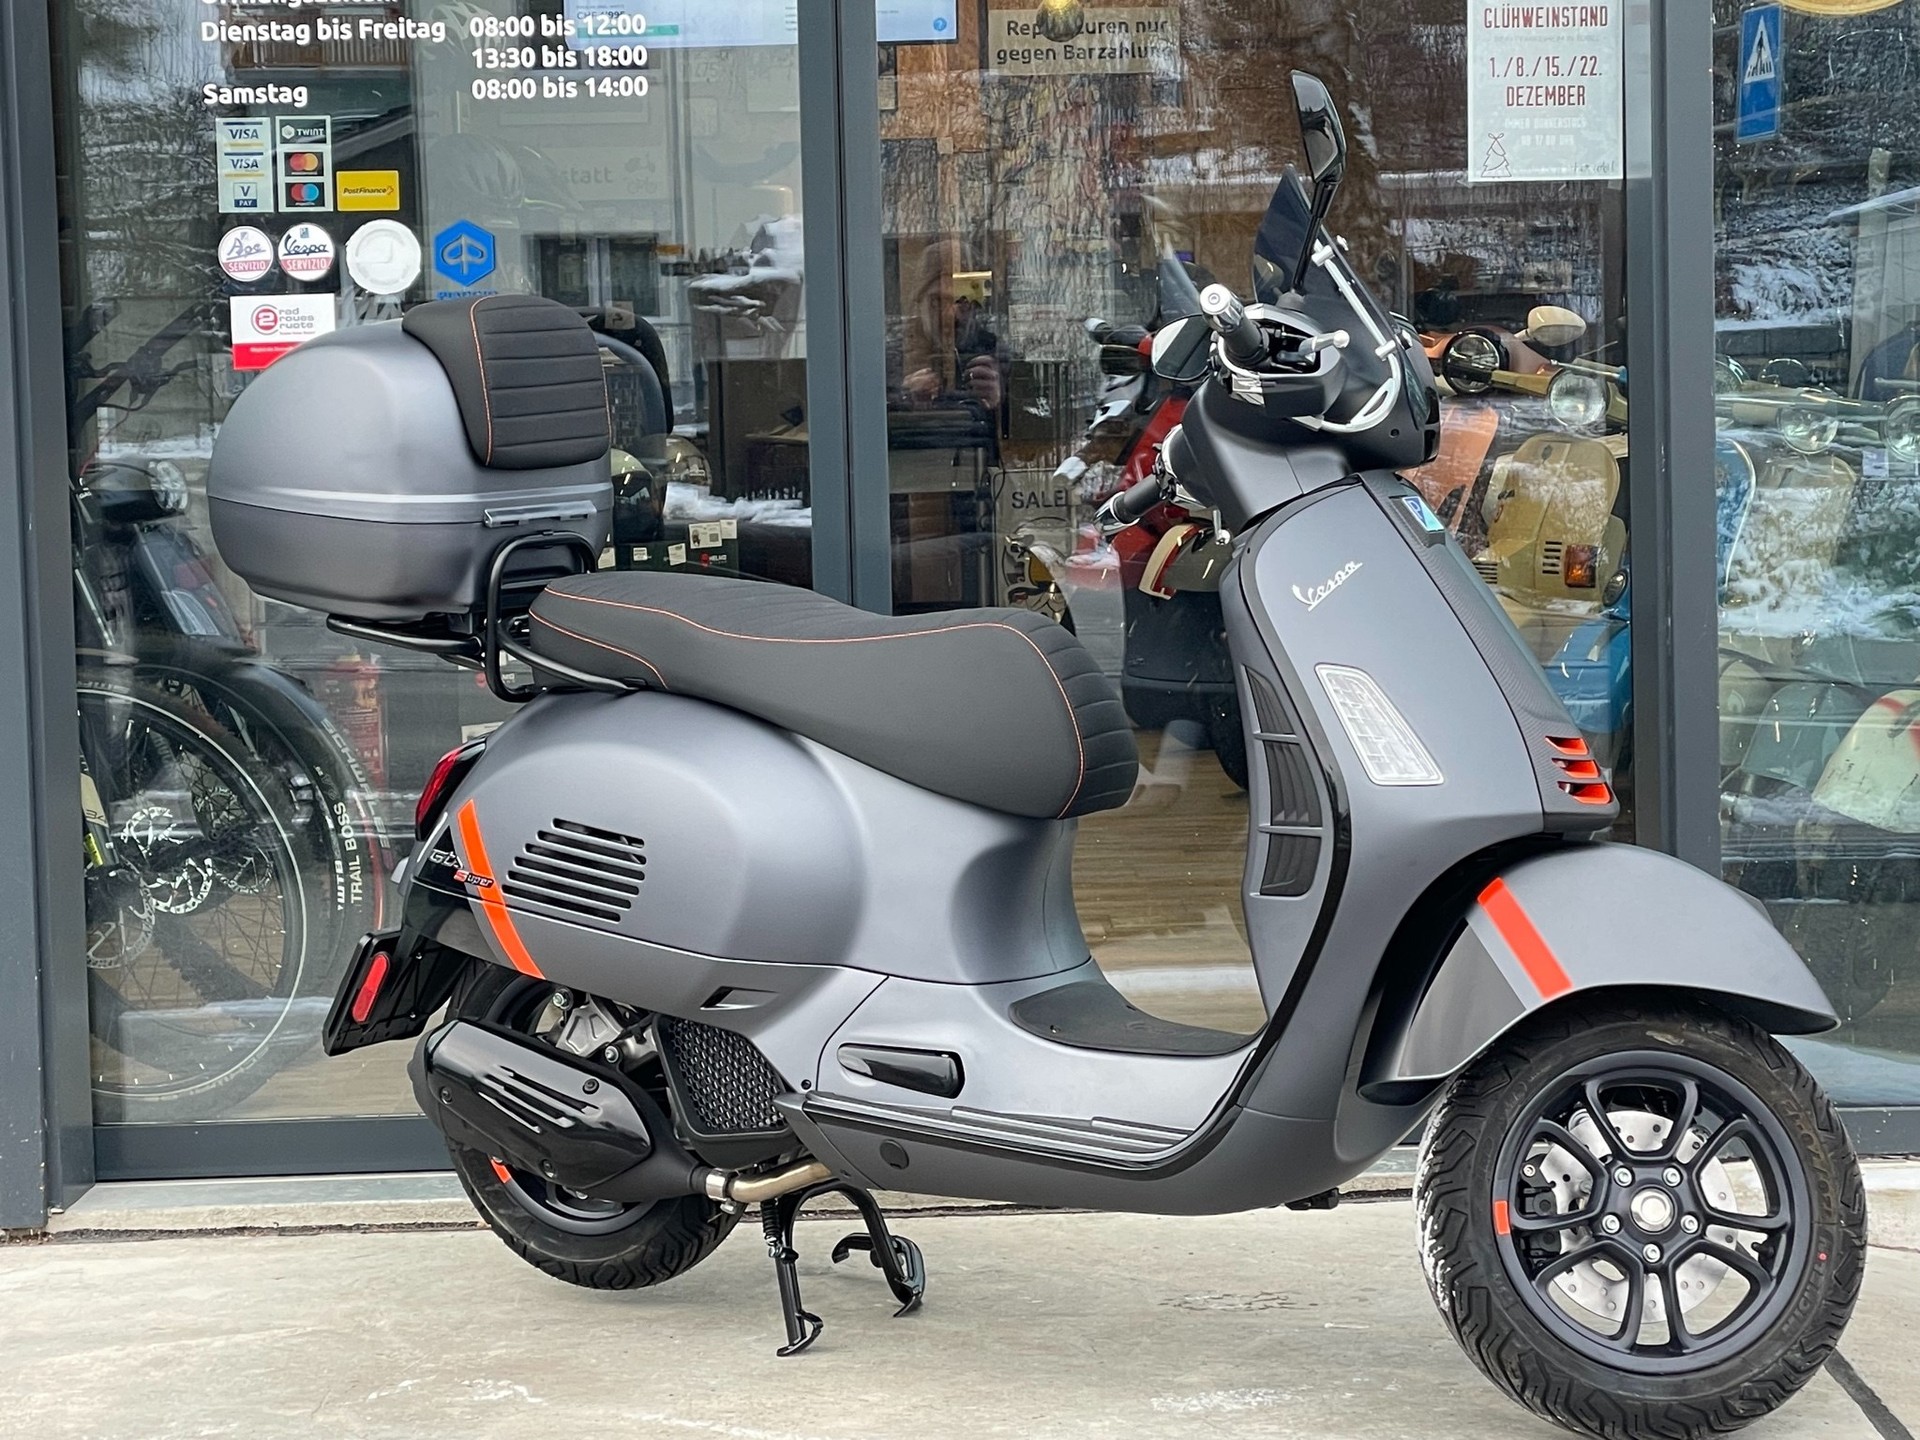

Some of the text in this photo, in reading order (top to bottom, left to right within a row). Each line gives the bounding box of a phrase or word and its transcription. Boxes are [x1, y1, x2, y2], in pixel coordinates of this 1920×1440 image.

[1484, 4, 1608, 28] GLÜHWEINSTAND
[201, 14, 646, 46] Dienstag bis Freitag 08:00 bis 12:00
[1135, 20, 1169, 34] nur
[472, 45, 648, 69] 13:30 bis 18:00
[997, 46, 1057, 65] gegen
[203, 76, 648, 108] Samstag 08:00 bis 14:00
[1506, 85, 1586, 107] DEZEMBER
[229, 128, 259, 140] VISA
[297, 128, 325, 136] TWINT
[231, 159, 259, 169] VISA
[240, 186, 251, 197] V
[343, 186, 389, 194] PostFinance
[226, 237, 267, 261] Ape
[282, 234, 329, 257] Vespa
[228, 260, 267, 272] SERVIZIO
[286, 258, 327, 271] SERVIZIO
[258, 311, 276, 327] 2
[278, 307, 300, 315] rad
[1011, 489, 1068, 509] SALE
[1291, 560, 1364, 612] Vespa
[333, 801, 363, 904] TRAIL BOSS
[453, 869, 493, 887] Super
